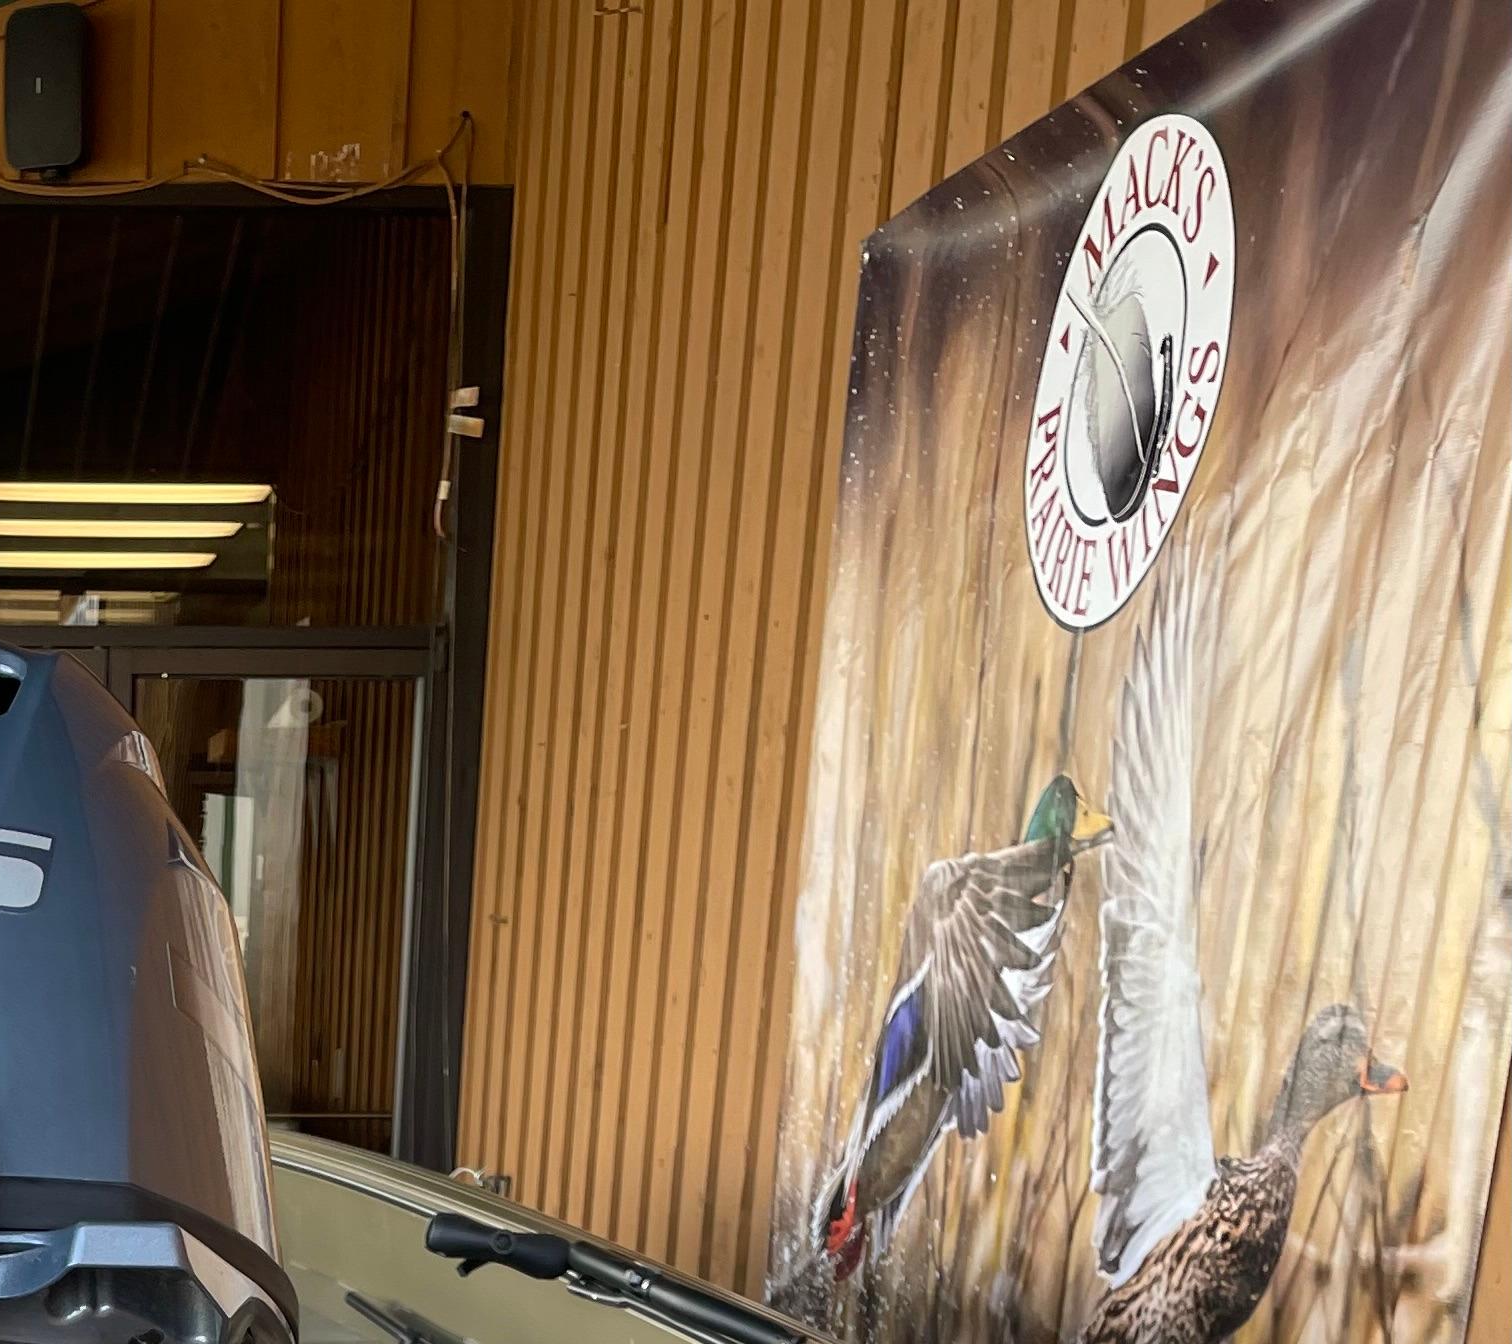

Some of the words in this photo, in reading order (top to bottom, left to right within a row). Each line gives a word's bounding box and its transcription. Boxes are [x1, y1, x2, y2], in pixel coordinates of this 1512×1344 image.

[1082, 127, 1216, 293] MACK'S
[1031, 402, 1097, 616] PRAIRIE
[1106, 340, 1220, 601] WINGS
